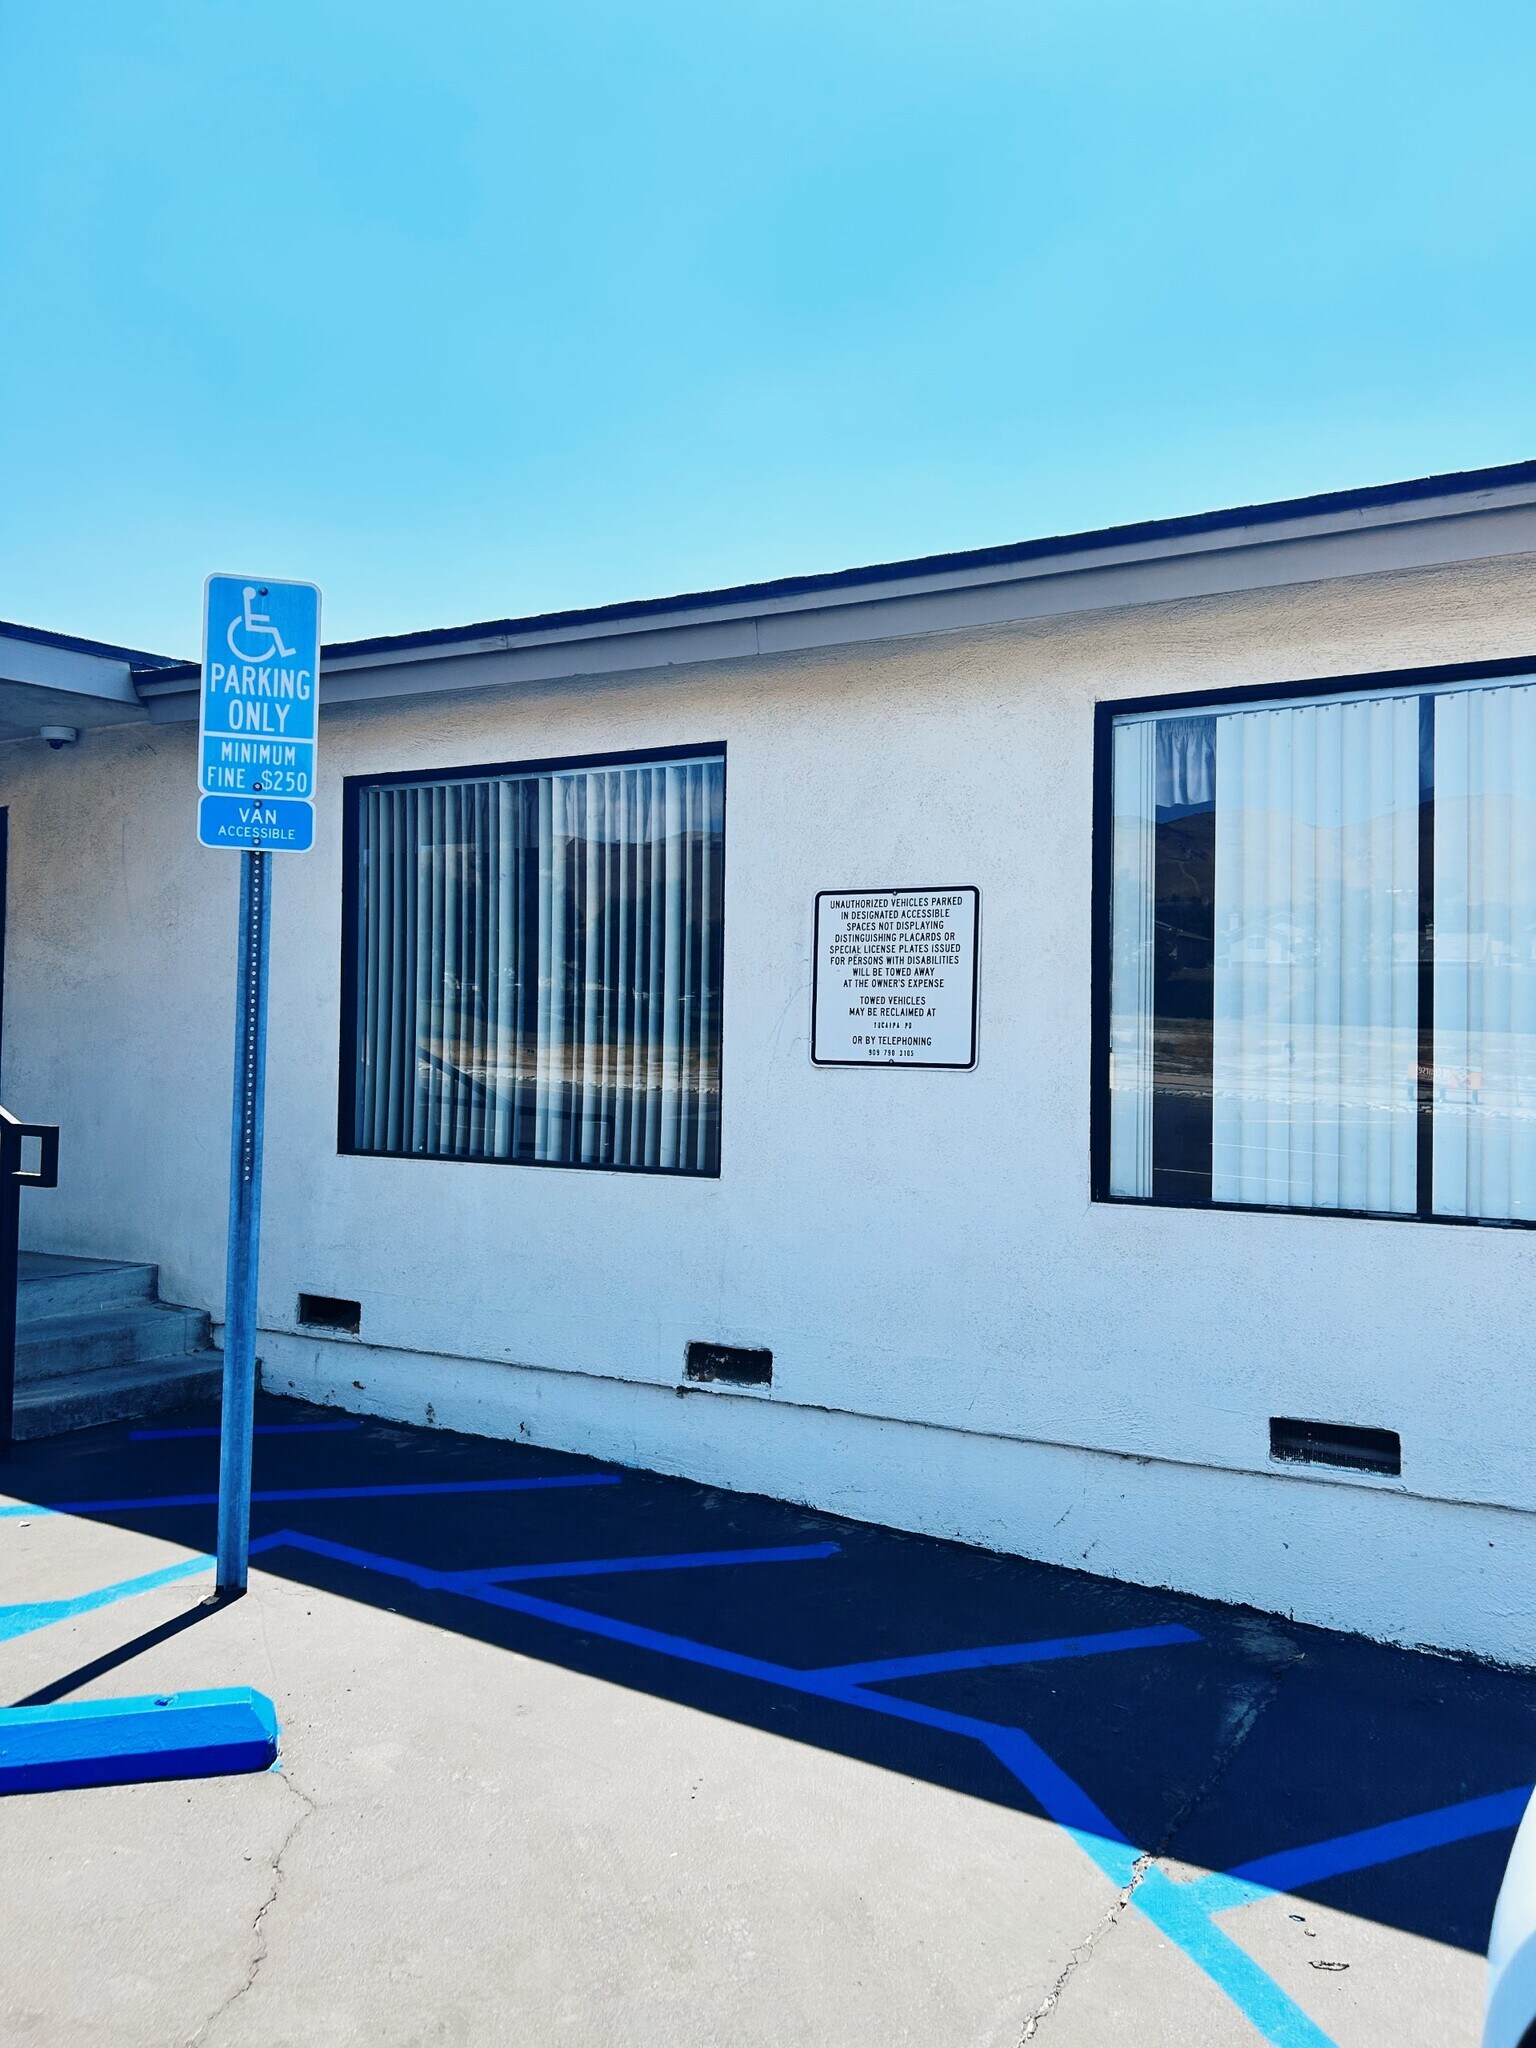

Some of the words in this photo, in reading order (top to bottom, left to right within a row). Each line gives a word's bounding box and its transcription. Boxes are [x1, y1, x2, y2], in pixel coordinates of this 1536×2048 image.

[211, 664, 309, 699] PARKING
[229, 699, 290, 732] ONLY
[221, 742, 295, 766] MINIMUM
[208, 766, 245, 788] FINE
[262, 770, 307, 792] $250
[239, 808, 276, 824] VAN
[218, 826, 295, 839] ACCESSIBLE
[830, 899, 889, 909] UNAUTHORIZED
[890, 898, 929, 908] VEHICLES
[931, 896, 963, 906] PARKED
[841, 911, 849, 920] IN
[851, 910, 899, 919] DESIGNATED
[900, 908, 950, 918] ACCESSIBLE
[846, 922, 876, 931] SPACES
[878, 922, 894, 931] NOT
[896, 921, 944, 930] DISPLAYING
[835, 933, 897, 943] DISTINGUISHING
[899, 932, 941, 942] PLACARDS
[944, 932, 956, 941] OR
[829, 945, 862, 954] SPECIAL
[864, 945, 896, 954] LICENSE
[899, 944, 929, 953] PLATES
[932, 943, 961, 953] ISSUED
[830, 956, 845, 965] FOR
[847, 956, 884, 965] PERSONS
[886, 956, 905, 965] WITH
[907, 955, 960, 965] DISABILITIES
[852, 968, 870, 977] WILL
[872, 968, 883, 977] BE
[885, 967, 912, 977] TOWED
[914, 967, 935, 976] AWAY
[843, 979, 852, 988] AT
[855, 979, 869, 988] THE
[871, 979, 906, 988] OWNER'S
[908, 979, 945, 988] EXPENSE
[860, 996, 886, 1005] TOWED
[888, 996, 926, 1006] VEHICLES
[849, 1007, 865, 1016] MAY
[867, 1008, 878, 1016] BE
[880, 1008, 924, 1017] RECLAIMED
[926, 1008, 936, 1017] AT
[852, 1035, 863, 1045] OR
[866, 1036, 876, 1045] BY
[878, 1036, 932, 1046] TELEPHONING
